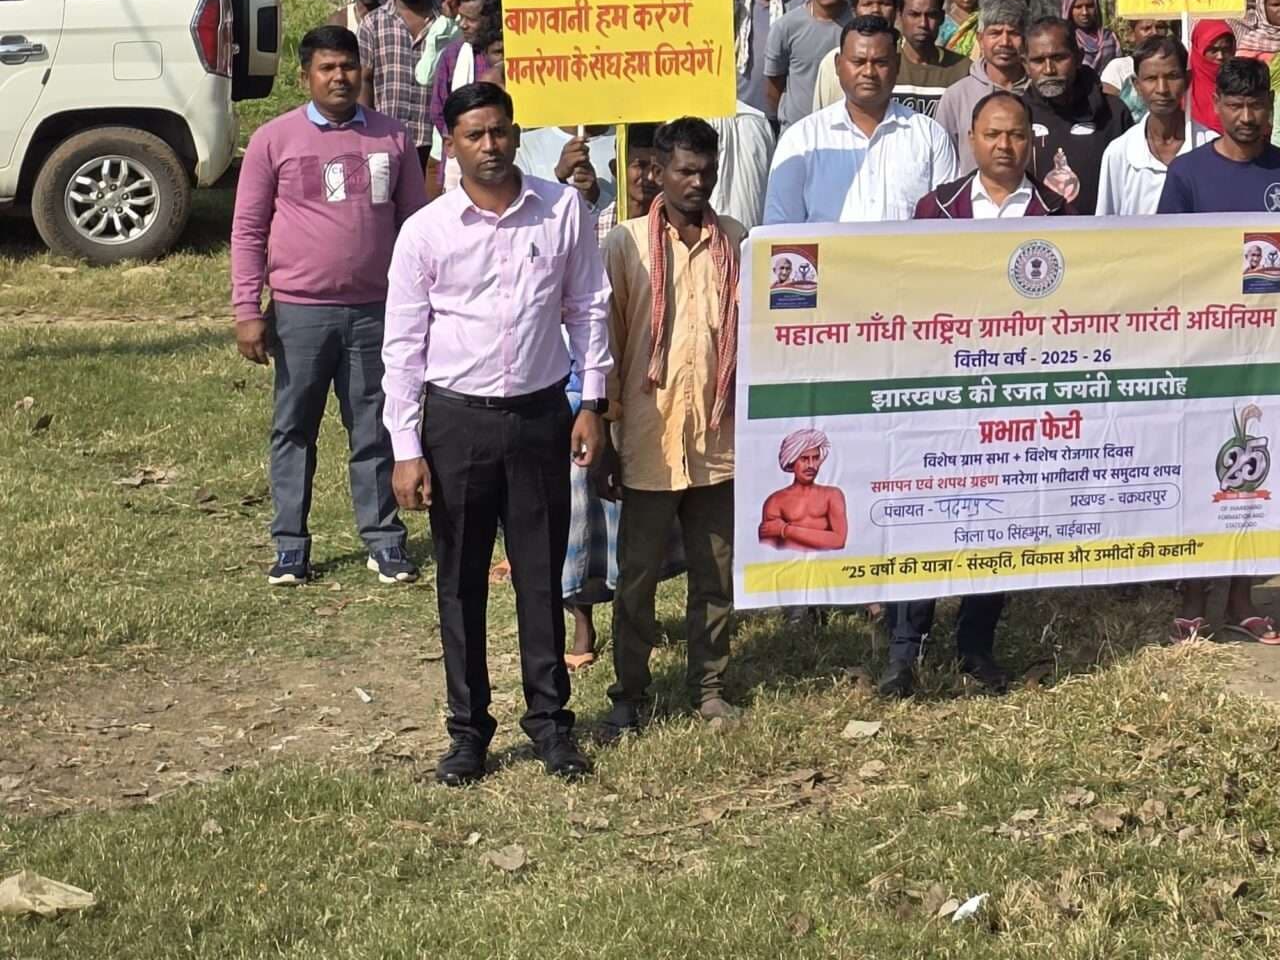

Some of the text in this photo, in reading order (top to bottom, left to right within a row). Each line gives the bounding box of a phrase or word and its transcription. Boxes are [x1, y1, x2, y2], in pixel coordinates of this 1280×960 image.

[596, 4, 629, 38] हम
[506, 48, 570, 86] मनरेगा
[623, 51, 650, 82] हम
[775, 304, 1277, 346] महात्मा गाँधी राष्ट्रिय ग्रामीण रोजगार गारंटी अधिनियम
[954, 349, 1000, 368] वित्तीय
[1003, 346, 1027, 366] वर्ष
[1041, 350, 1078, 364] 2025
[1093, 348, 1112, 362] 26
[871, 370, 1188, 411] झारखण्ड की रजत जयंती समारोह
[978, 409, 1083, 444] प्रभात फेरी
[924, 452, 956, 468] विशेष
[960, 453, 982, 466] ग्राम
[986, 452, 1010, 464] सभा
[1025, 448, 1057, 462] विशेष
[1061, 446, 1100, 460] रोजगार
[1103, 444, 1134, 458] दिवस
[870, 464, 1181, 493] समापन एवं शपथ ग्रहण मनरेगा भागीदारी पर समुदाय शपथ
[884, 501, 924, 518] पंचायत
[1070, 494, 1106, 508] प्रखण्ड
[954, 527, 984, 544] जिला
[870, 556, 896, 576] वर्षों
[899, 557, 917, 574] की
[921, 559, 952, 573] यात्रा
[1022, 548, 1064, 567] विकास
[1068, 545, 1090, 563] और
[1094, 542, 1134, 562] उम्मीदों
[1138, 542, 1155, 558] की
